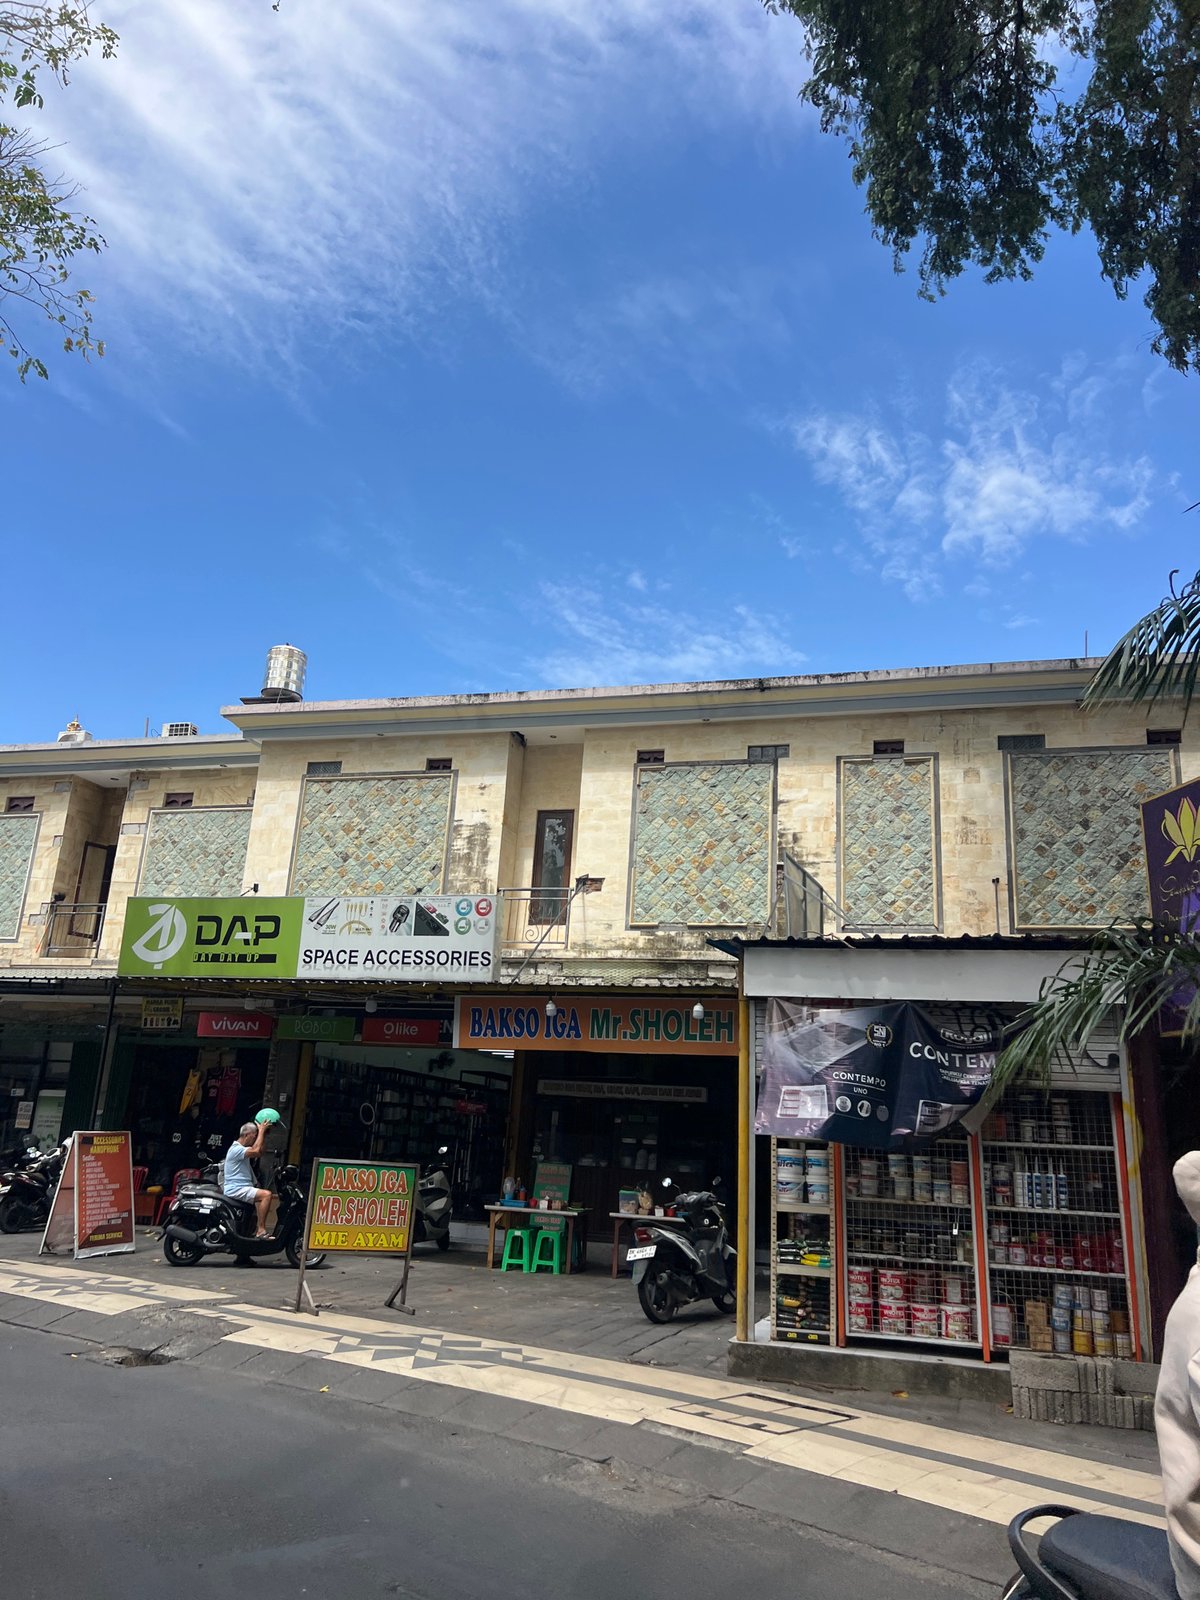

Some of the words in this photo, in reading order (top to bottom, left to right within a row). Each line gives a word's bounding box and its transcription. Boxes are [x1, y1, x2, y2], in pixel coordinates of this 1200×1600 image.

[195, 915, 281, 946] DAP
[193, 951, 213, 963] DAY
[219, 951, 240, 963] DAY
[246, 952, 260, 963] UP
[302, 949, 359, 965] SPACE
[362, 950, 492, 967] ACCESSORIES
[294, 1019, 339, 1034] ROBOT
[469, 1006, 539, 1039] BAKSO
[544, 1007, 582, 1040] IGA
[588, 1007, 734, 1044] Mr.SHOLEH
[832, 1071, 887, 1087] CONTEMPO
[853, 1087, 868, 1095] UNO
[93, 1136, 126, 1145] ACCESSORIES
[321, 1166, 378, 1193] BAKSO
[379, 1169, 408, 1195] IGA
[314, 1195, 410, 1228] MR.SHOLEH
[314, 1230, 349, 1247] MIE
[352, 1231, 404, 1248] AYAM
